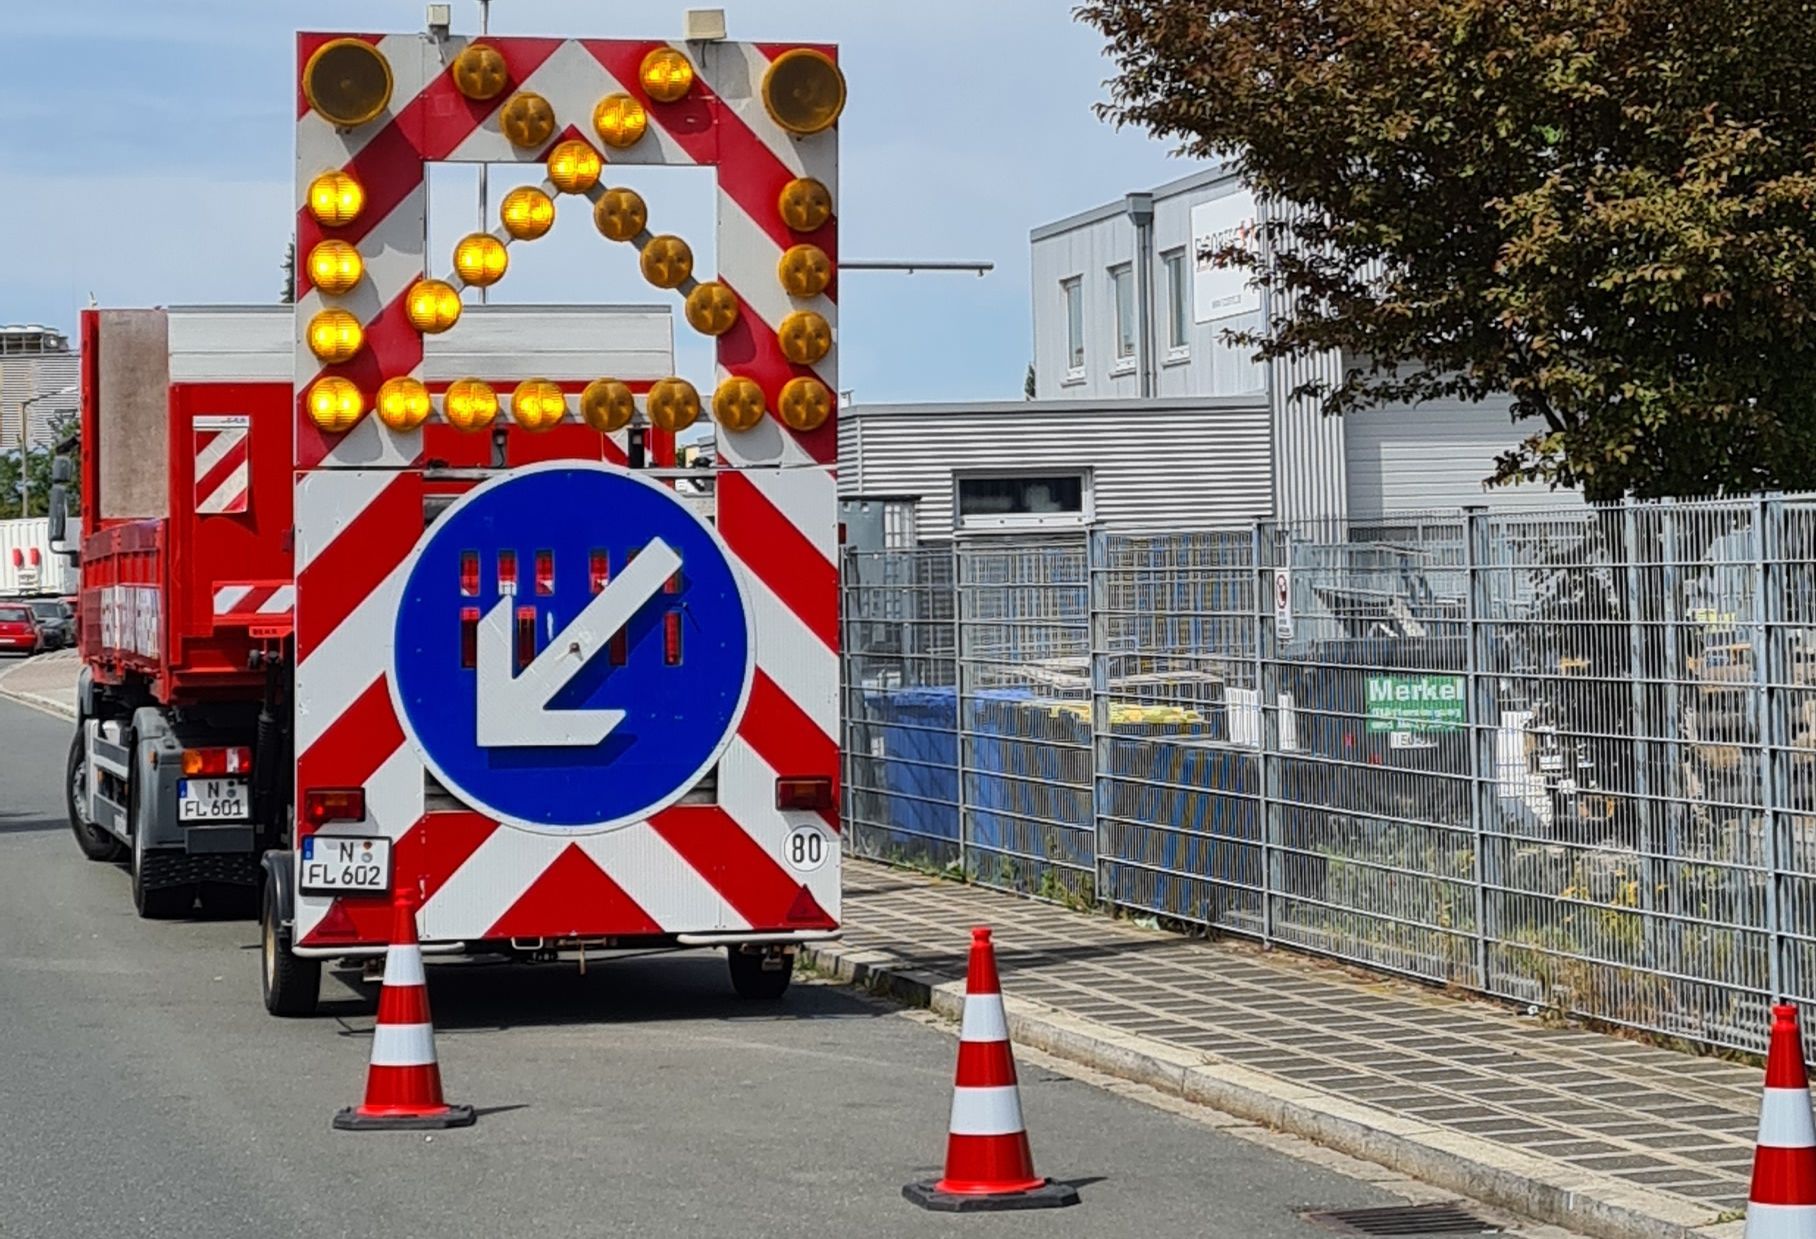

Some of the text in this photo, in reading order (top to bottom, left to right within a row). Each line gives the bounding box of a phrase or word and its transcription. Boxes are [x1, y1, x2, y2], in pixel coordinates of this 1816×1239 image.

[1369, 679, 1464, 701] Merkel
[208, 781, 220, 799] N
[185, 799, 243, 816] FL 601
[340, 842, 354, 863] N
[792, 833, 821, 863] 80
[309, 864, 380, 885] FL 602
